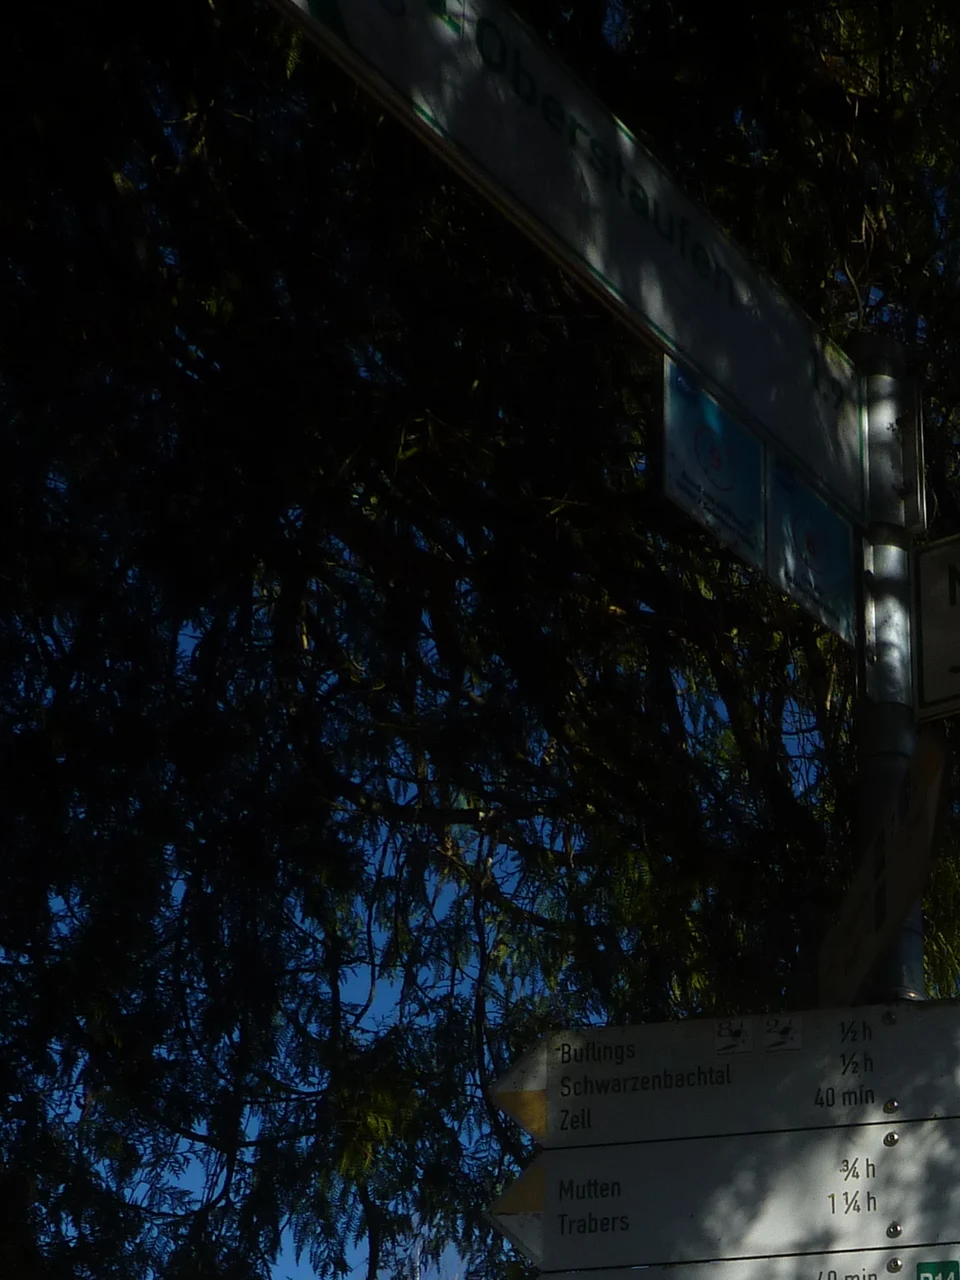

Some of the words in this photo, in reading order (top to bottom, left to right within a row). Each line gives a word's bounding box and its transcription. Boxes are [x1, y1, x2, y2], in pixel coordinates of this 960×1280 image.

[561, 1043, 635, 1065] Buflings
[561, 1064, 732, 1096] Schwarzenbachtal
[815, 1088, 835, 1108] 40
[842, 1085, 875, 1107] min
[558, 1180, 621, 1202] Mutten
[558, 1213, 630, 1235] Trabers
